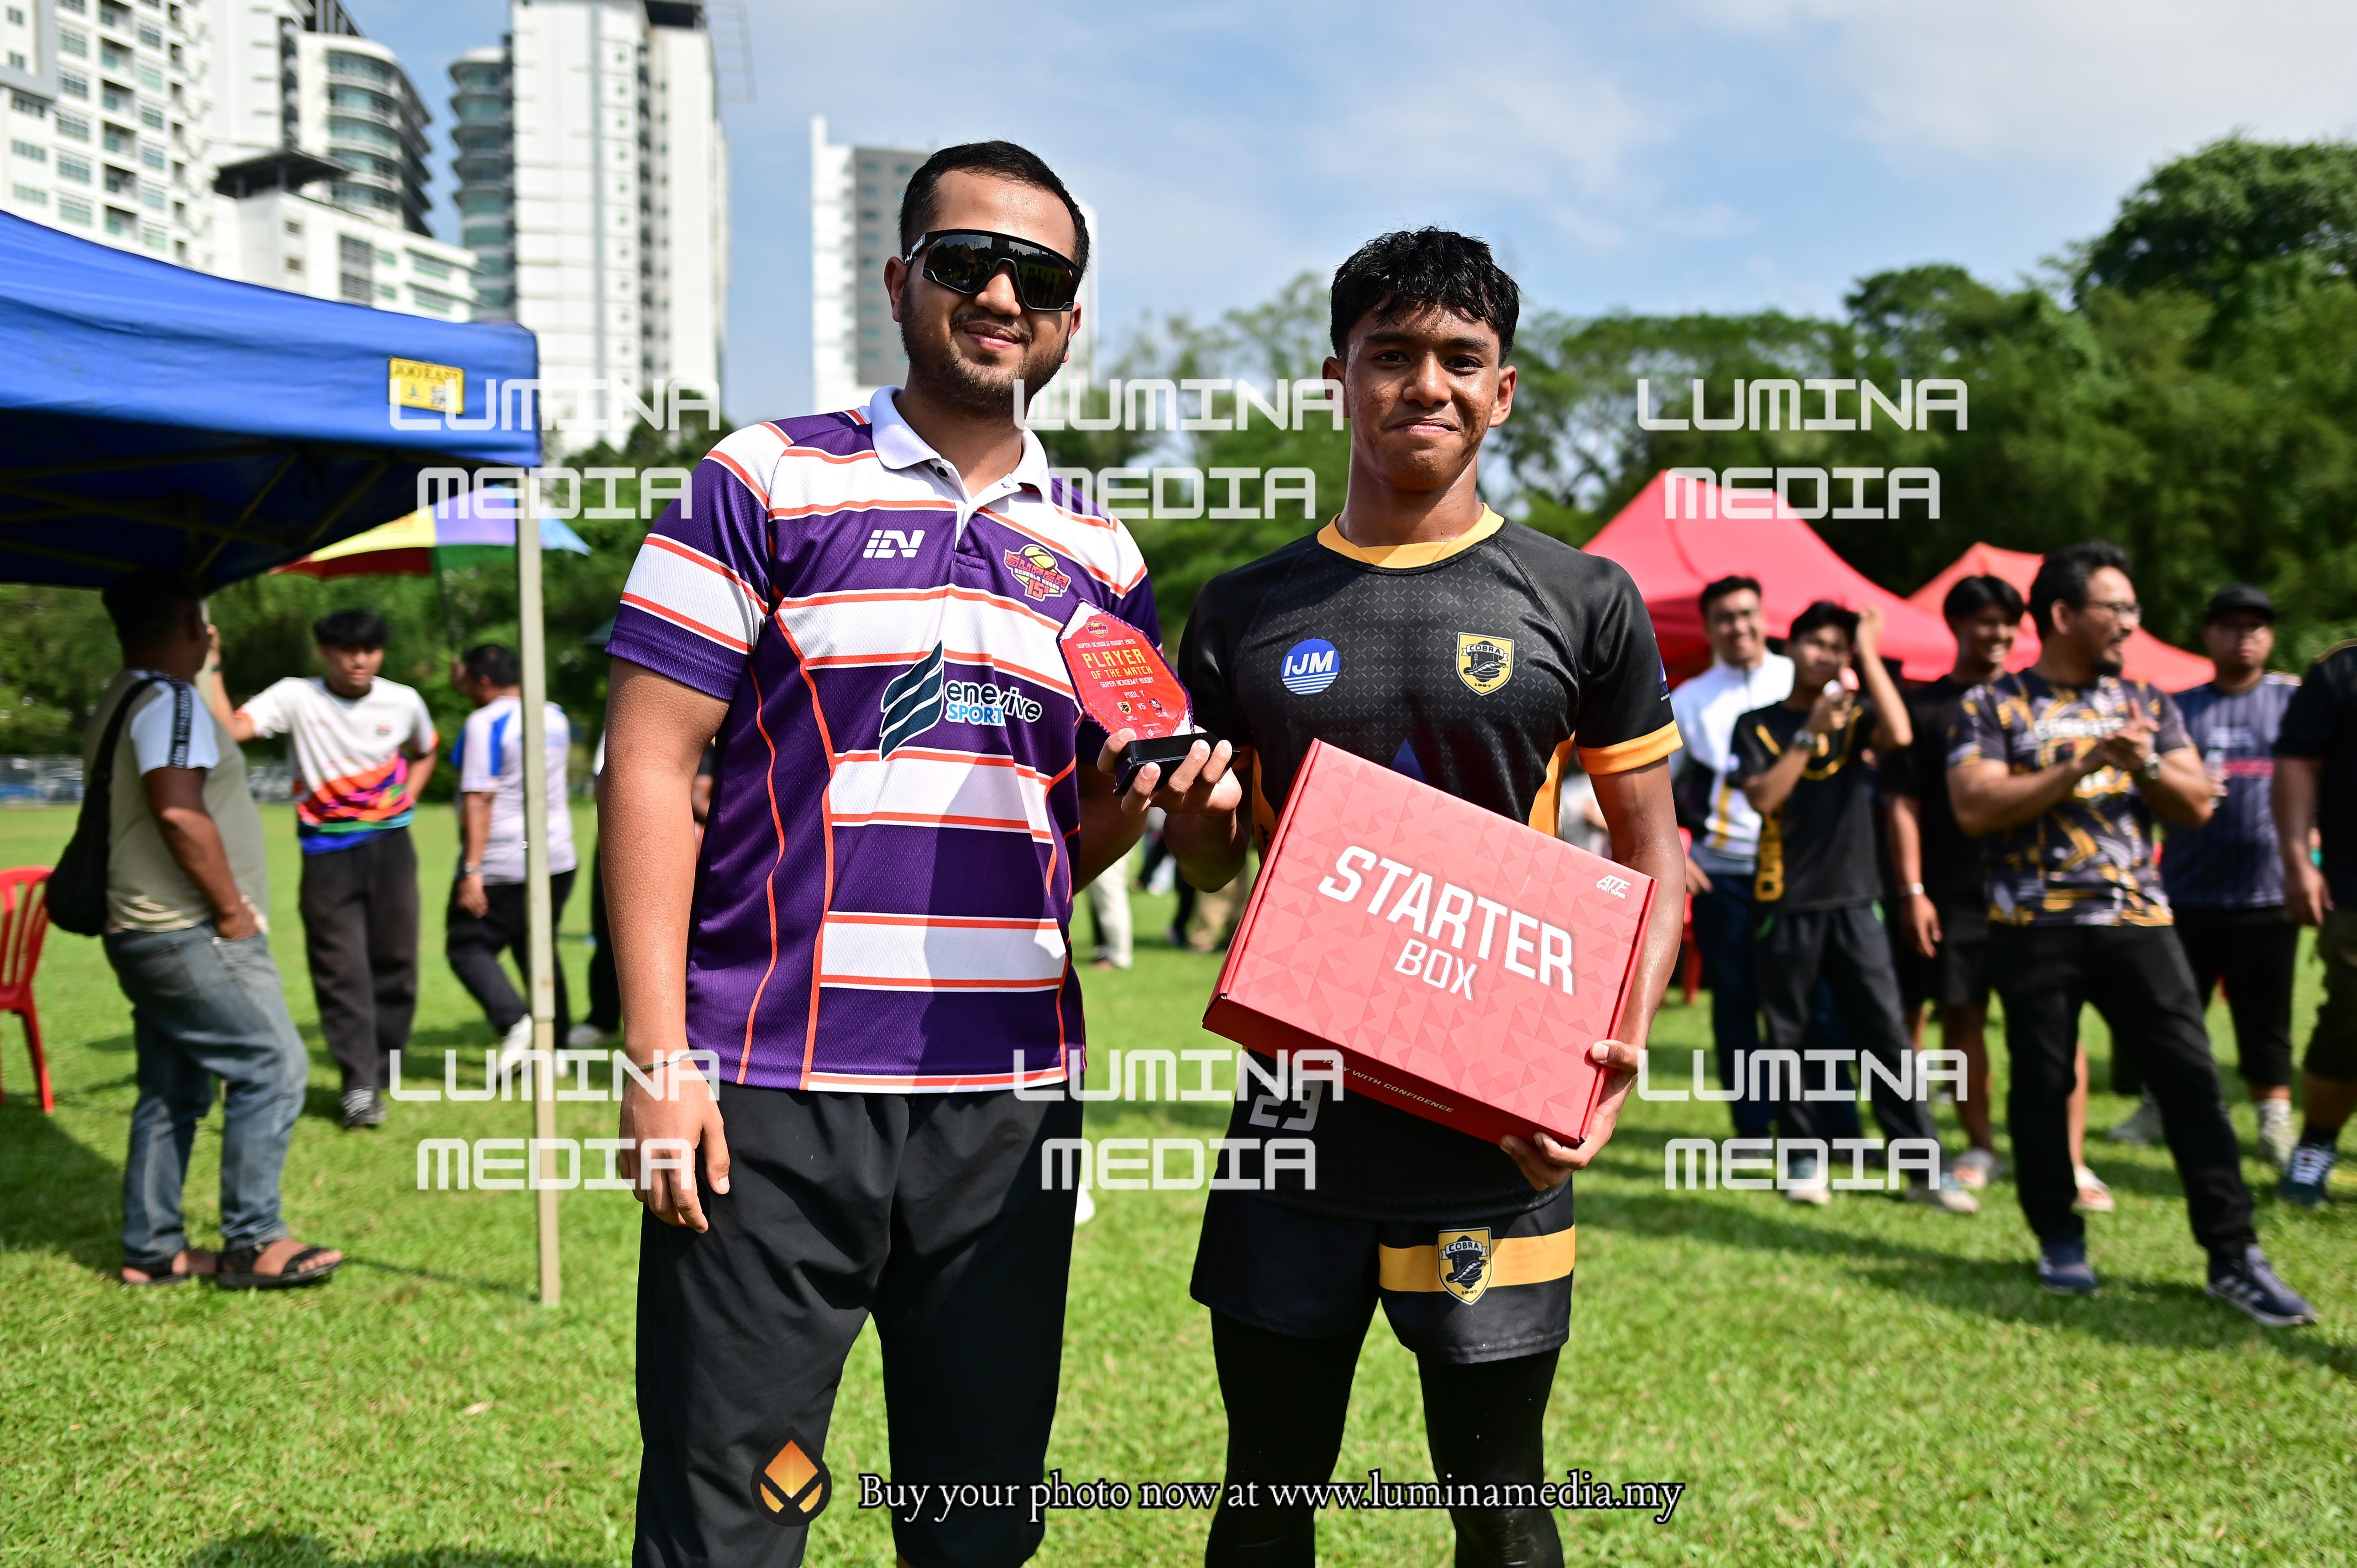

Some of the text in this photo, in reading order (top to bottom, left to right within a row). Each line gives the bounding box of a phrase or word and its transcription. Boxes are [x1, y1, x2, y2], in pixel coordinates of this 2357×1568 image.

[1005, 553, 1069, 589] SUPER
[1014, 568, 1041, 582] SCHOOLS
[1081, 649, 1147, 668] PLAYER
[1284, 650, 1334, 676] IJM
[1470, 645, 1501, 655] COBRA
[1090, 666, 1153, 679] OF THE MATCH
[1318, 845, 1574, 996] STARTER
[1394, 938, 1478, 1001] BOX
[1323, 1059, 1454, 1112] PLAY WITH CONFIDENCE
[1249, 1075, 1323, 1131] 23
[1449, 1242, 1479, 1251] COBRA
